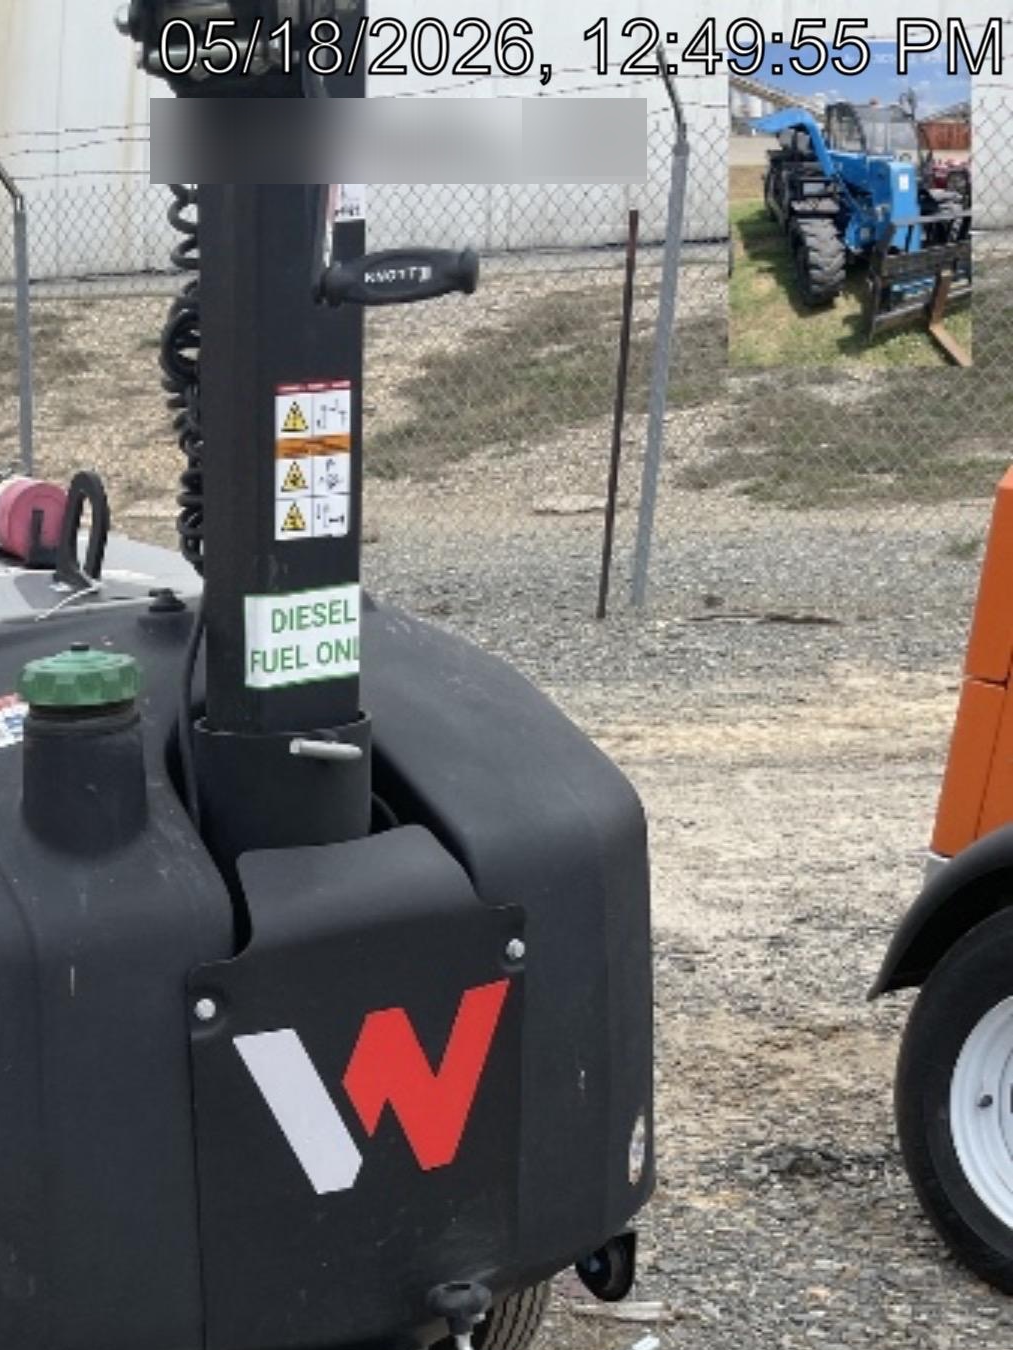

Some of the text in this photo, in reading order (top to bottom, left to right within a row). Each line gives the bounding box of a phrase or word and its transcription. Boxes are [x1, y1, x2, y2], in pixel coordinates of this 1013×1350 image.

[271, 599, 357, 634] DIESEL
[250, 636, 360, 674] FUEL ONL
